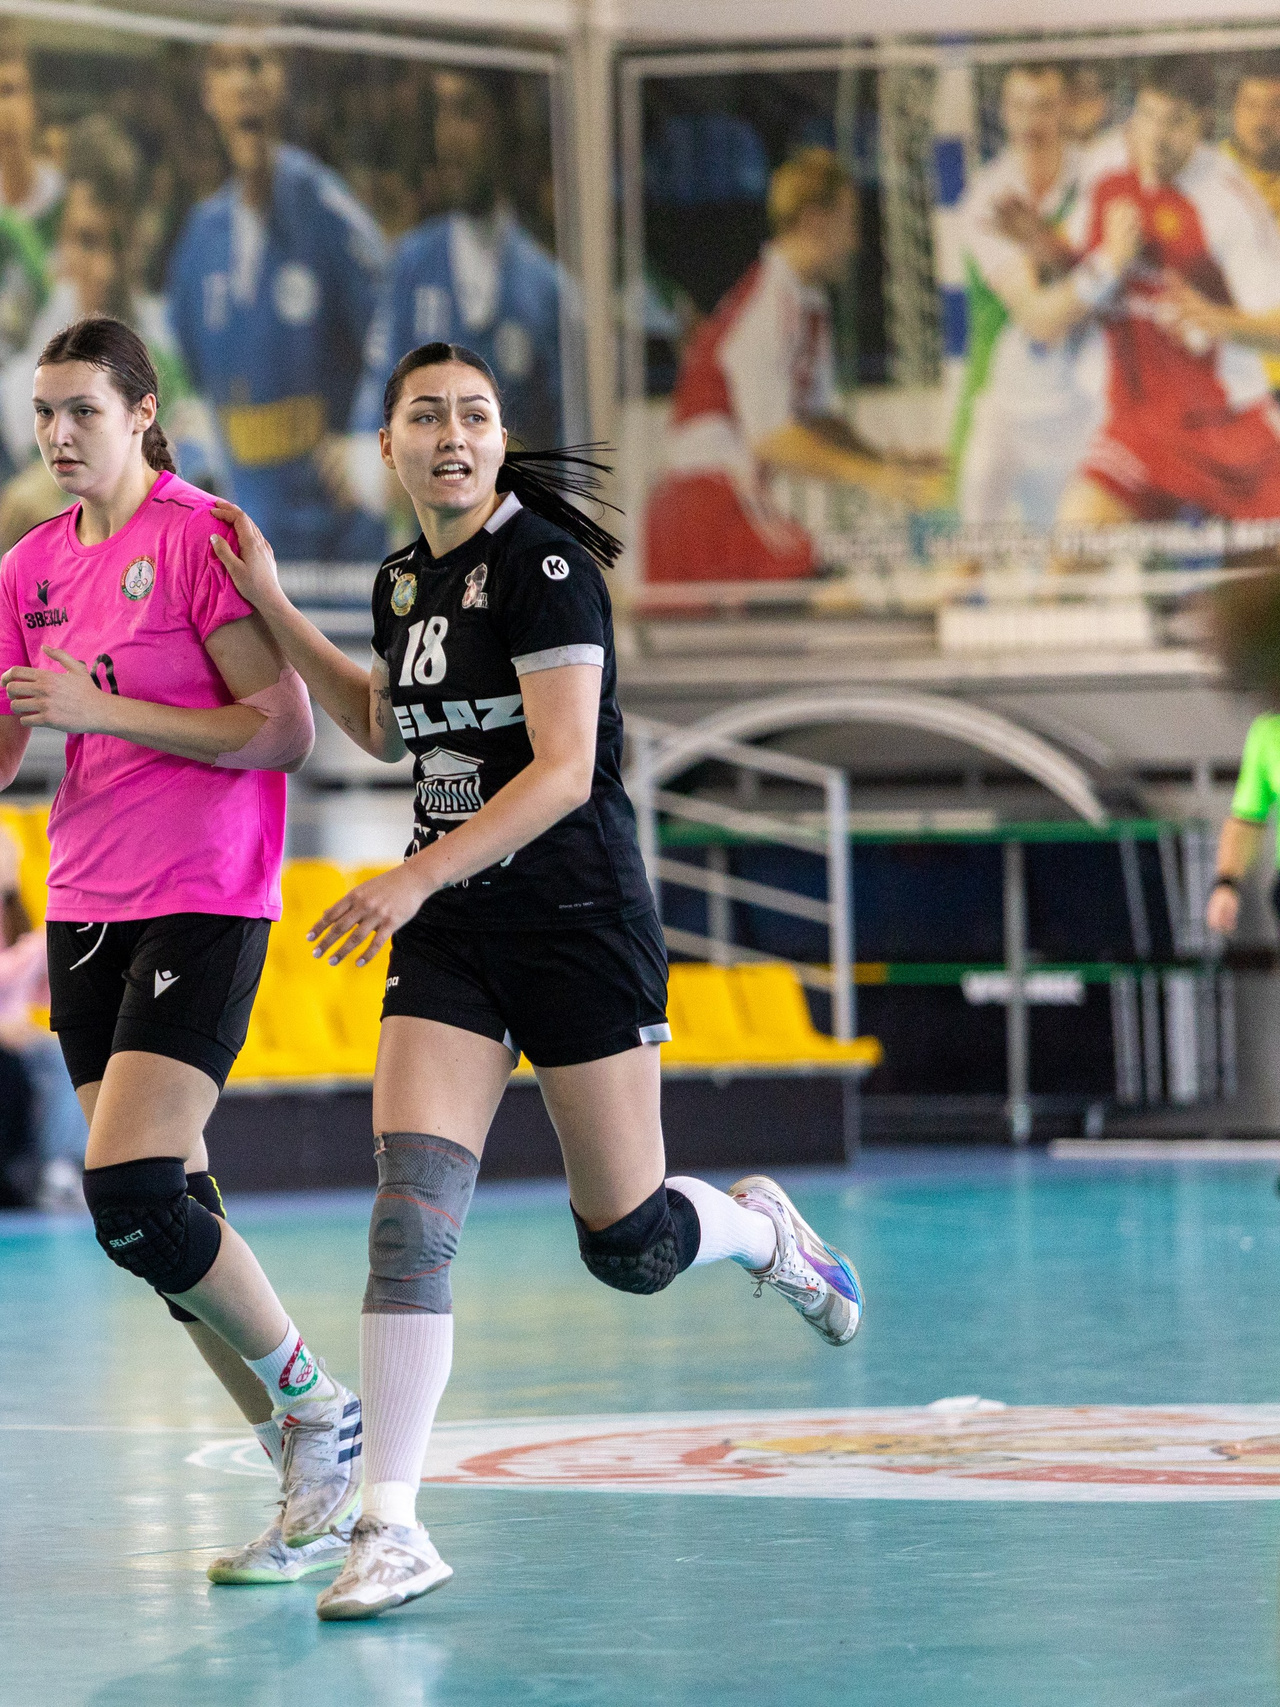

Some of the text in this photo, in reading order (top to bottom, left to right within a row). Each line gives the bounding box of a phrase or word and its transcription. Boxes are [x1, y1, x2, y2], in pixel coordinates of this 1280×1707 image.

[24, 606, 68, 629] ЗВЕЗДА
[398, 616, 448, 686] 18
[109, 1229, 144, 1248] SELECT
